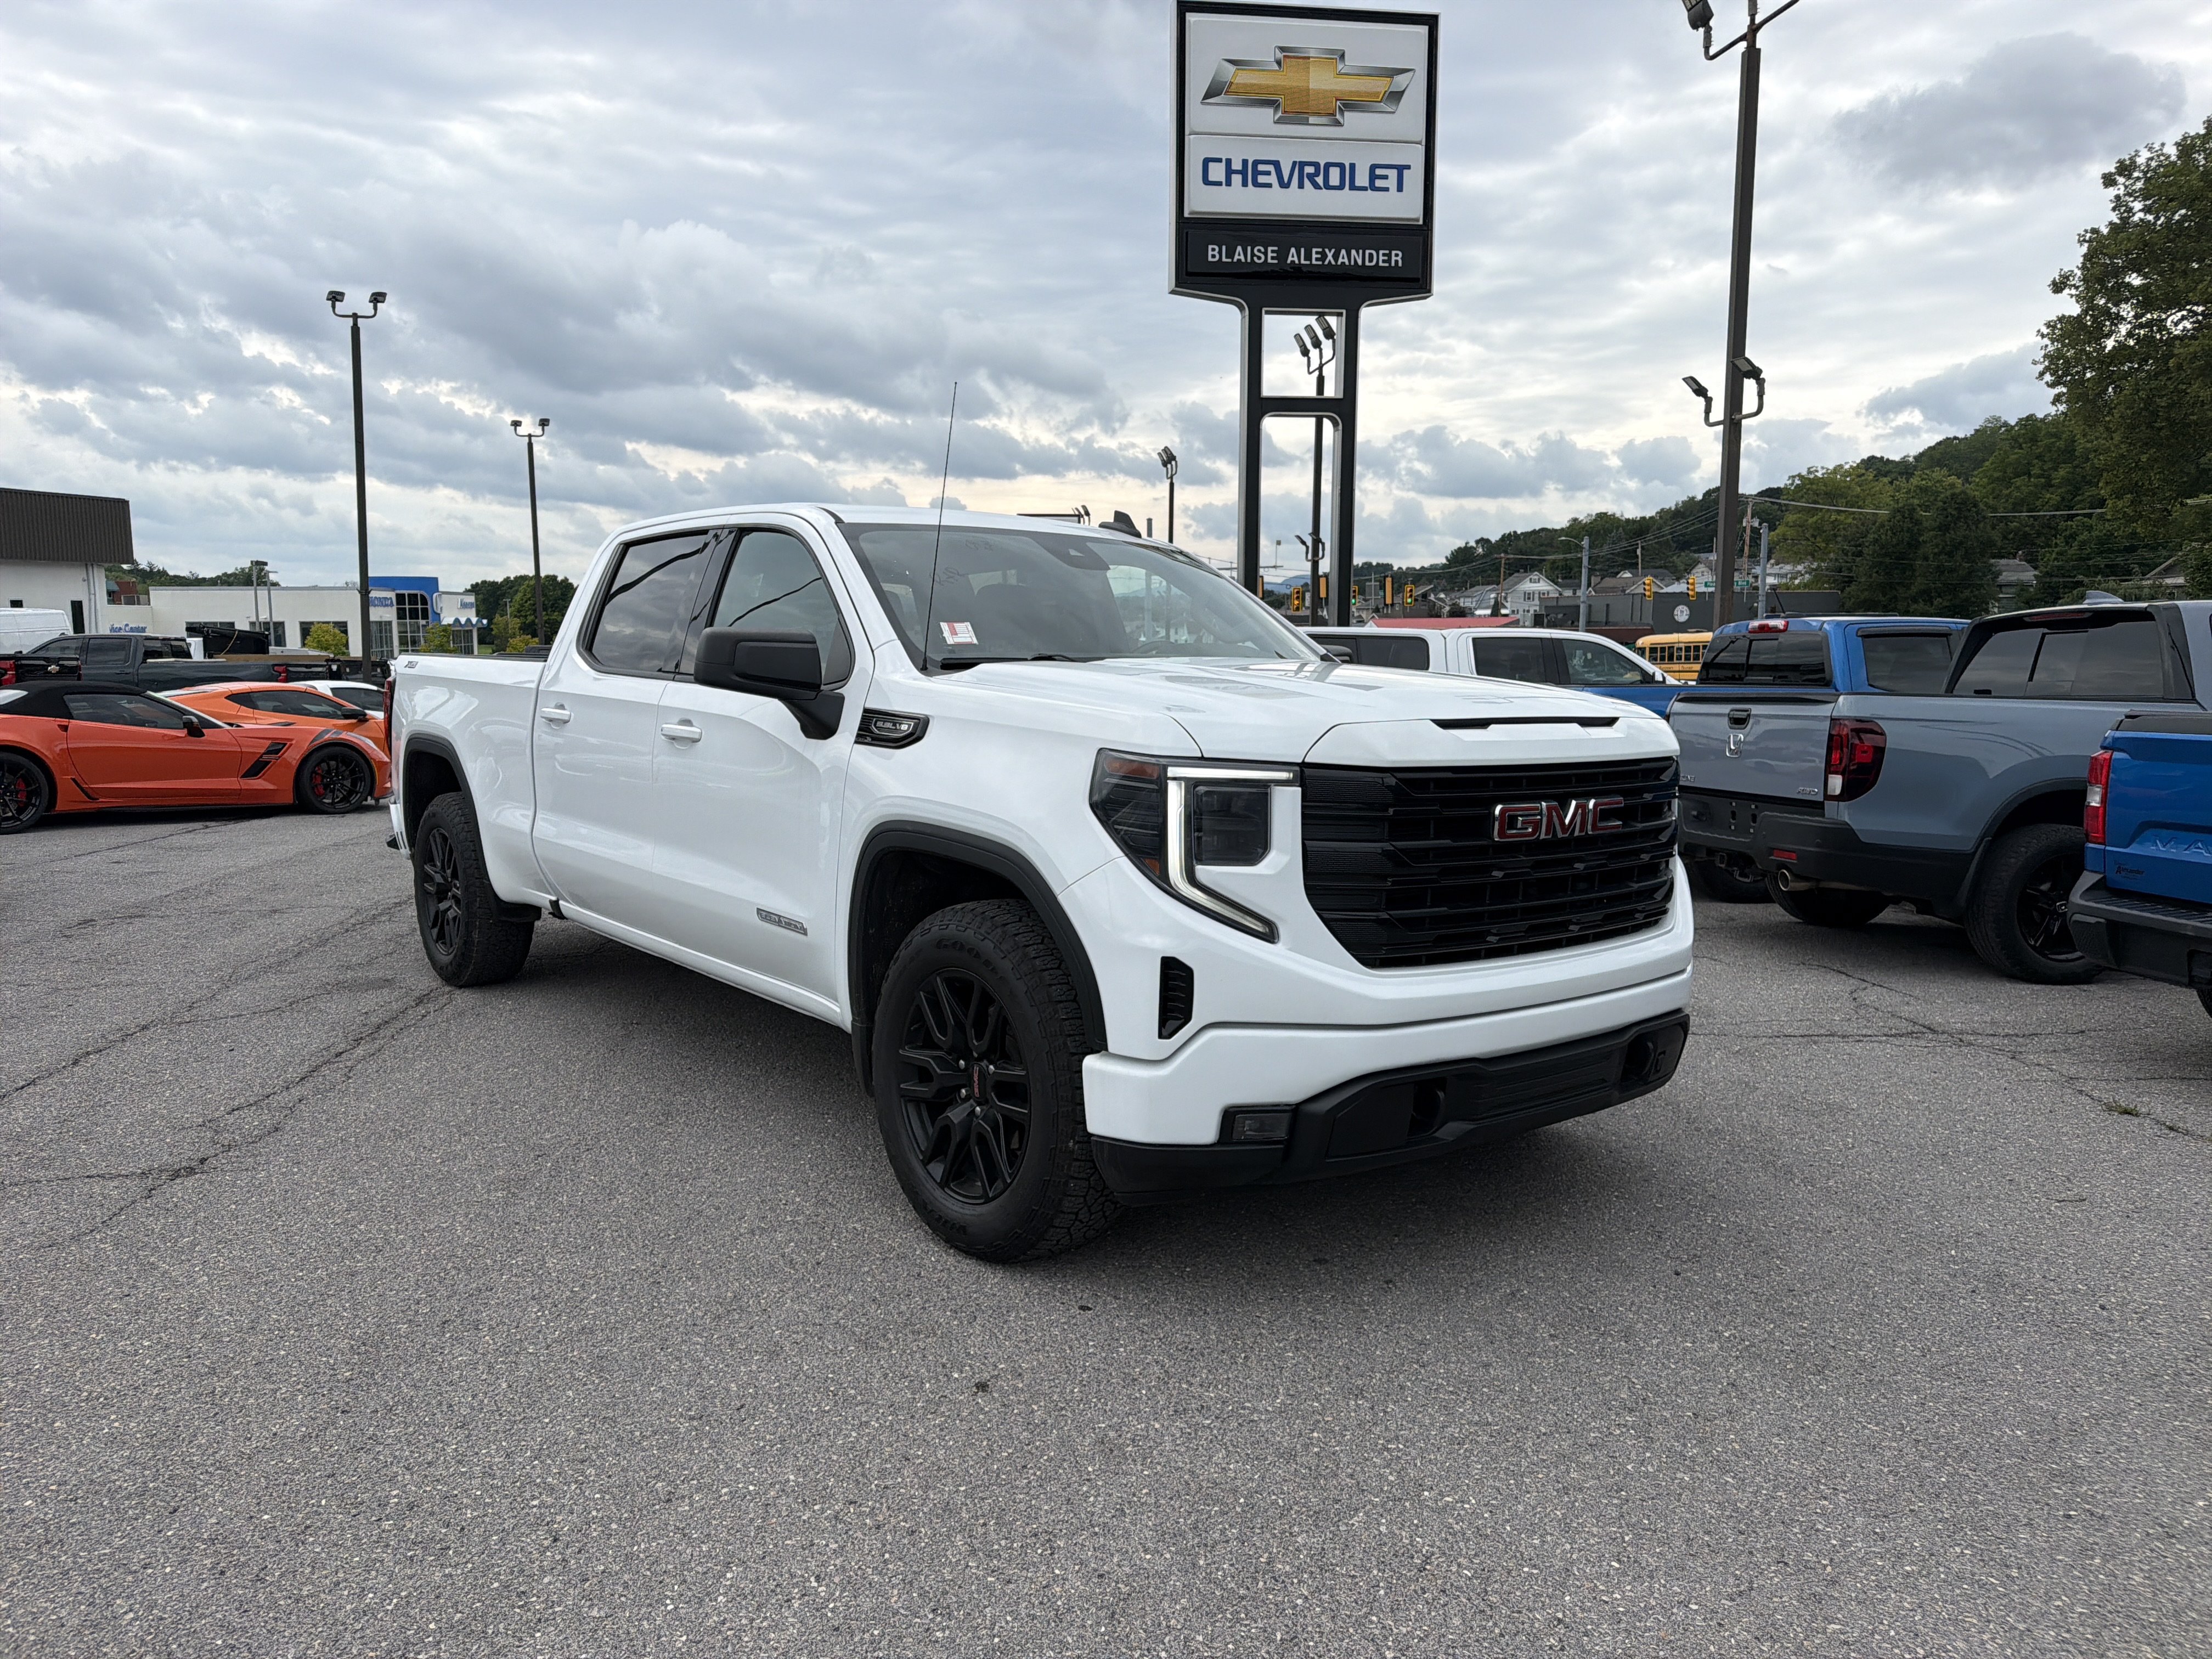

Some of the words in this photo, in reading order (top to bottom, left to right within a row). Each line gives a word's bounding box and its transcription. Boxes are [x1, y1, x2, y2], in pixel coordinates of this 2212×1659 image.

[1201, 156, 1411, 193] CHEVROLET
[1207, 244, 1279, 264] BLAISE
[1286, 247, 1403, 267] ALEXANDER
[1493, 795, 1624, 841] GMC
